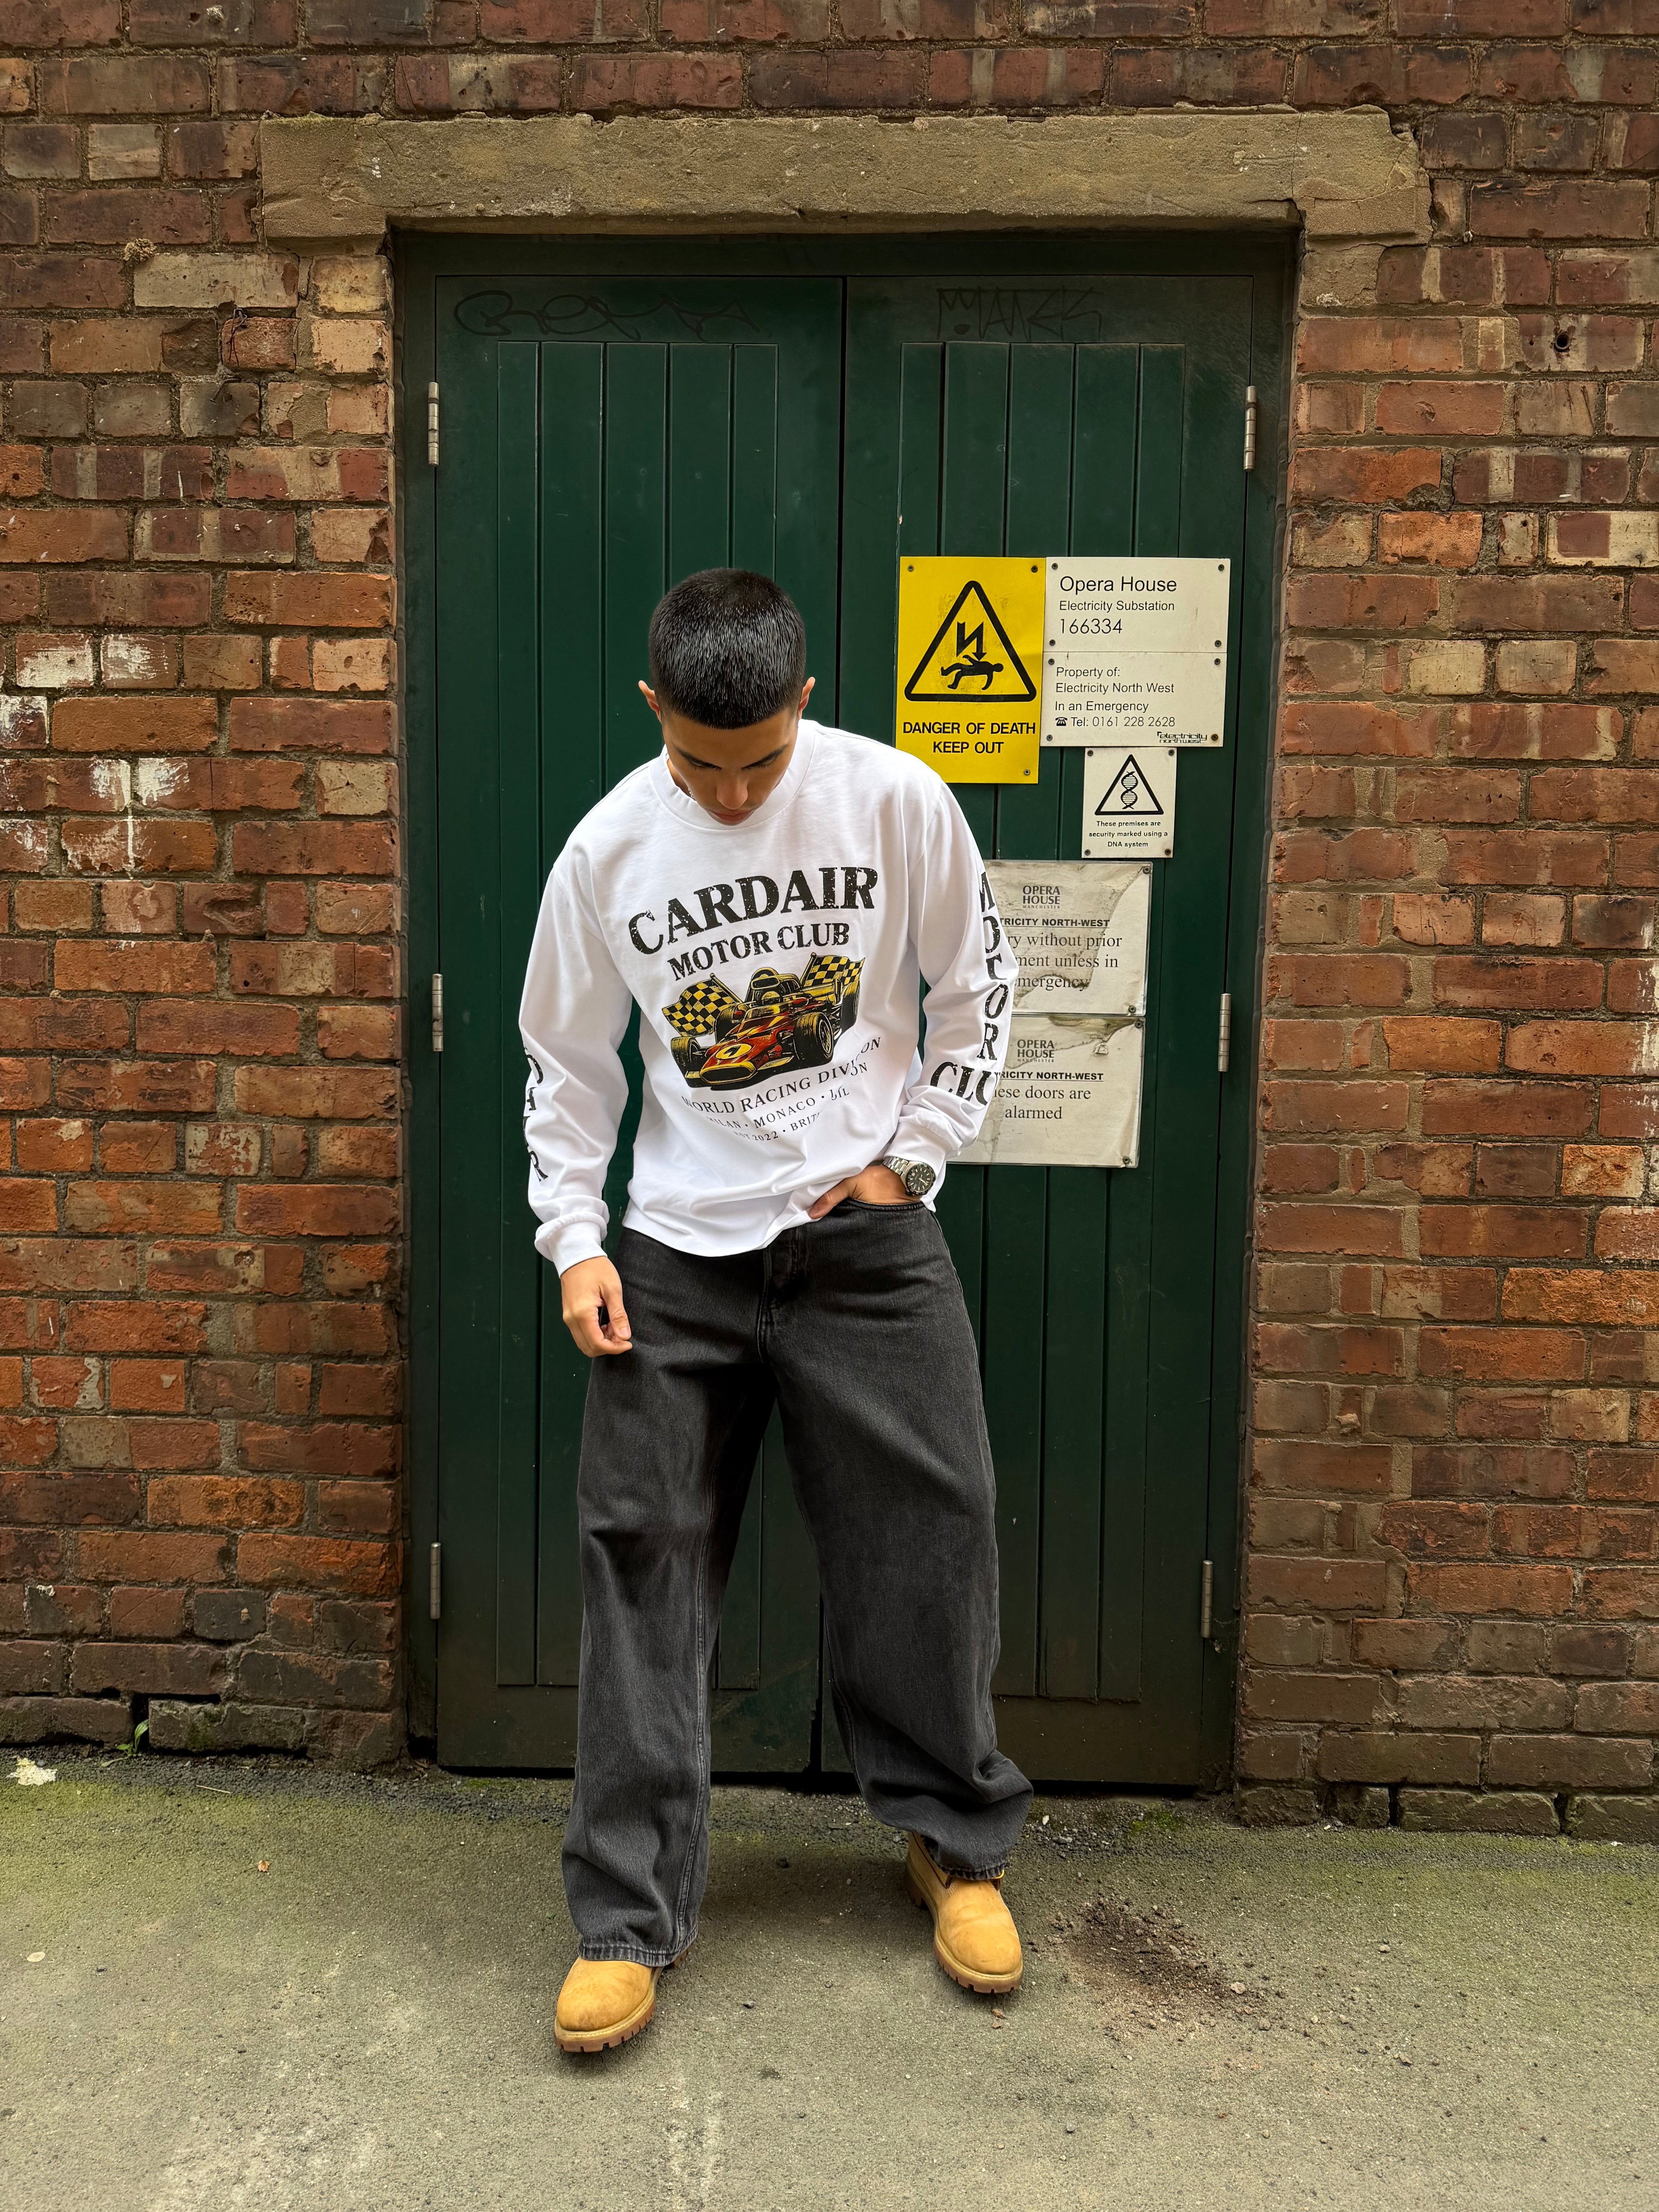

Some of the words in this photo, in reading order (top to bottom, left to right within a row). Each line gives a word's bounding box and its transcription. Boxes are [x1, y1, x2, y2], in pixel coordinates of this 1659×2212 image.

[1060, 576, 1114, 595] Opera
[1121, 576, 1177, 592] House
[1060, 600, 1113, 613] Electricity
[1116, 600, 1175, 611] Substation
[1060, 618, 1123, 634] 166334
[1056, 667, 1103, 679] Property
[1106, 667, 1120, 677] of:
[1056, 682, 1109, 695] Electricity
[1113, 683, 1142, 693] North
[1146, 683, 1175, 693] West
[1054, 701, 1065, 711] In
[1068, 703, 1082, 711] an
[1086, 701, 1149, 713] Emergency
[903, 721, 960, 734] DANGER
[966, 722, 986, 735] OF
[991, 722, 1036, 735] DEATH
[1071, 717, 1089, 727] Tel:
[1092, 716, 1118, 727] 0161
[1124, 716, 1144, 727] 228
[1148, 716, 1175, 727] 2628
[933, 741, 969, 753] KEEP
[975, 741, 1005, 754] OUT
[1023, 885, 1060, 895] OPERA
[1023, 895, 1060, 905] HOUSE
[628, 867, 878, 955] CARDAIR
[1042, 919, 1110, 927] NORTH-WEST
[1027, 933, 1082, 946] without
[1086, 933, 1123, 949] prior
[667, 931, 773, 981] MOTOR
[777, 923, 850, 950] CLUB
[1055, 955, 1099, 968] unless
[1104, 954, 1119, 968] in
[1015, 977, 1089, 991] mergency
[1017, 1039, 1054, 1049] OPERA
[1017, 1049, 1054, 1058] HOUSE
[1036, 1072, 1104, 1080] NORTH-WEST
[681, 1096, 735, 1113] WORLD
[740, 1077, 811, 1113] RACING
[1025, 1085, 1065, 1099] doors
[1069, 1090, 1091, 1099] are
[753, 1097, 816, 1129] MONACO
[1005, 1105, 1063, 1119] alarmed
